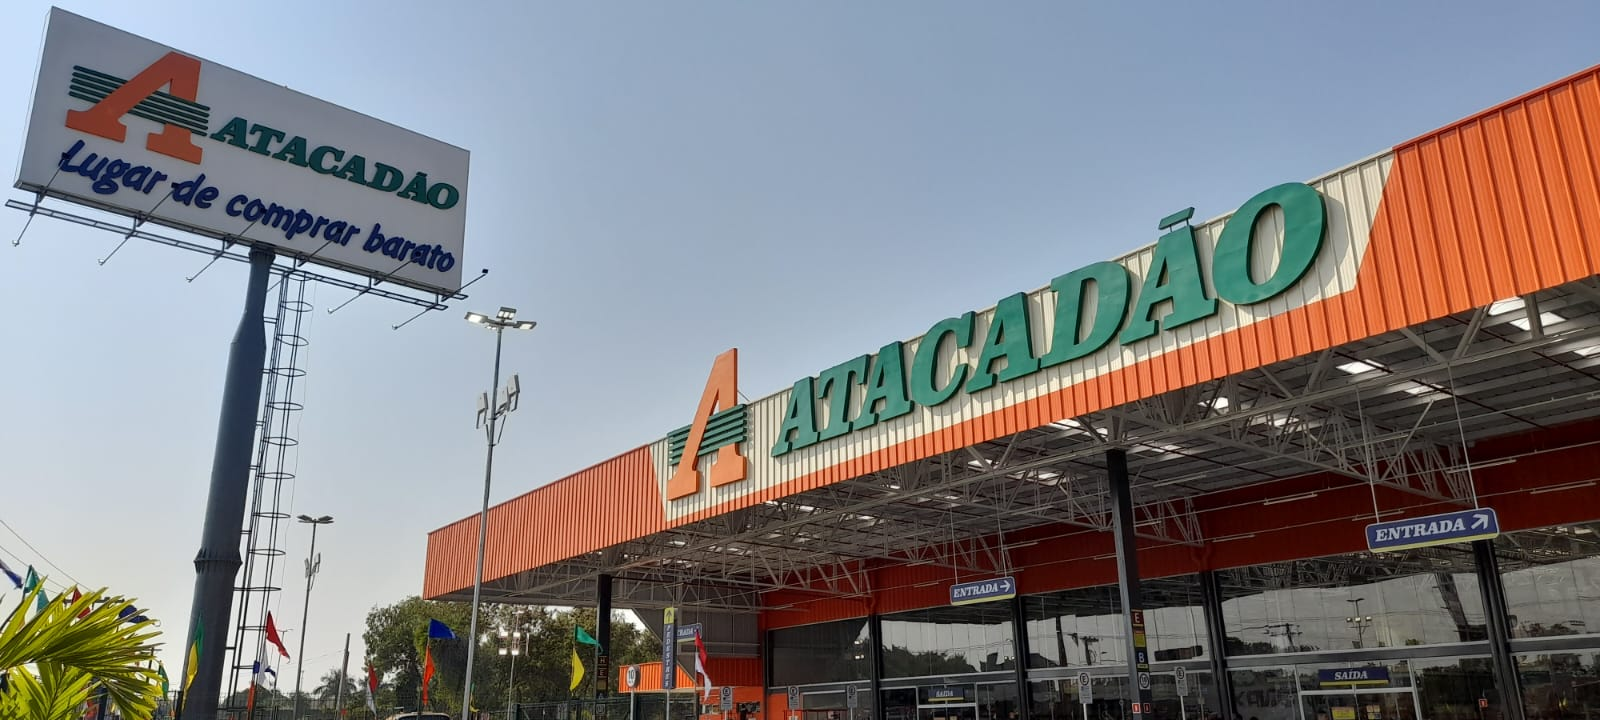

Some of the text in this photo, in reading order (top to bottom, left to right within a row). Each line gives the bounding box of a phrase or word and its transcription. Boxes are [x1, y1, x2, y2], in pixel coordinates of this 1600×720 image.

[210, 116, 460, 210] ATACADÃO
[58, 139, 456, 273] Lugar de comprar barato
[770, 181, 1328, 457] ATACADÃO
[1375, 518, 1466, 542] ENTRADA
[953, 583, 998, 598] ENTRADA
[1134, 612, 1141, 624] E
